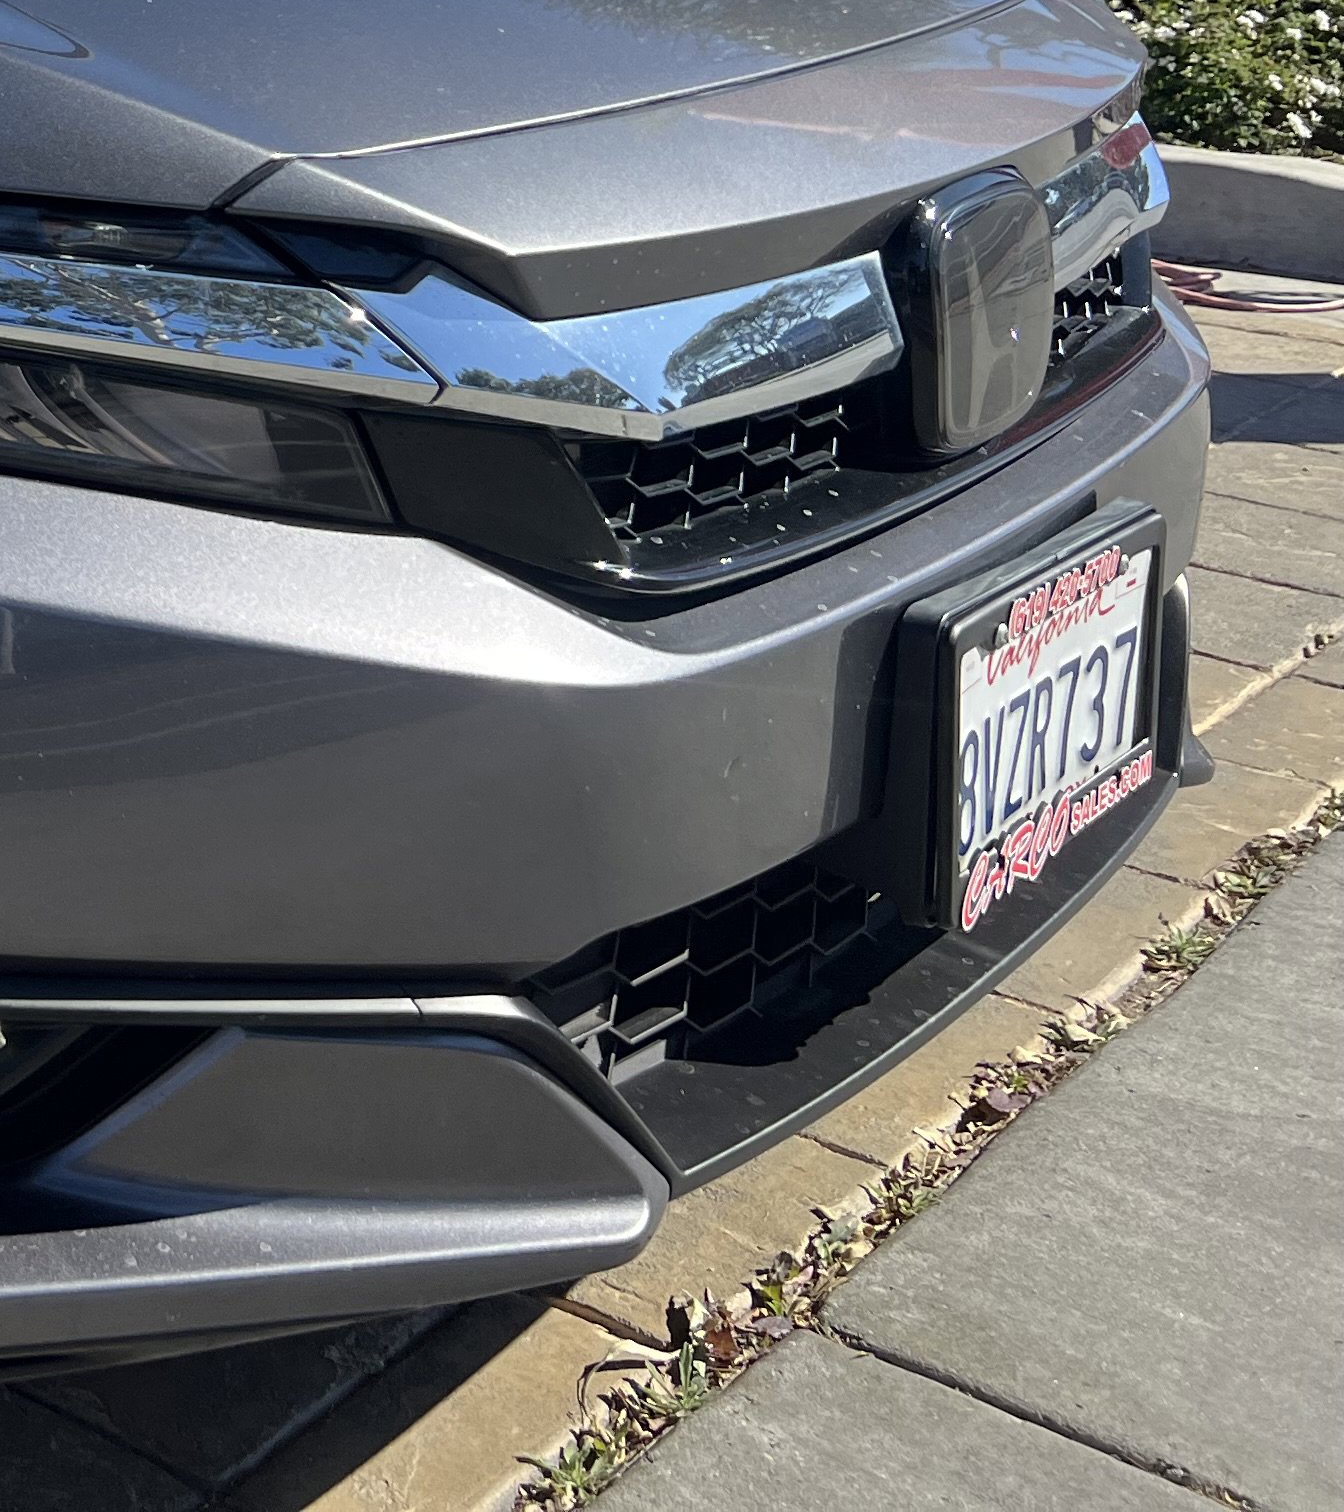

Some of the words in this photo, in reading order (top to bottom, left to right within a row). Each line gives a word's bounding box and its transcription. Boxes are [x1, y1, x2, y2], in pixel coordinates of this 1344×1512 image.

[1008, 581, 1052, 642] (619)
[1049, 544, 1122, 615] 420-5700
[958, 625, 1139, 858] 8VZR737
[961, 792, 1071, 932] CARCO
[1070, 749, 1154, 835] SALES.COM
